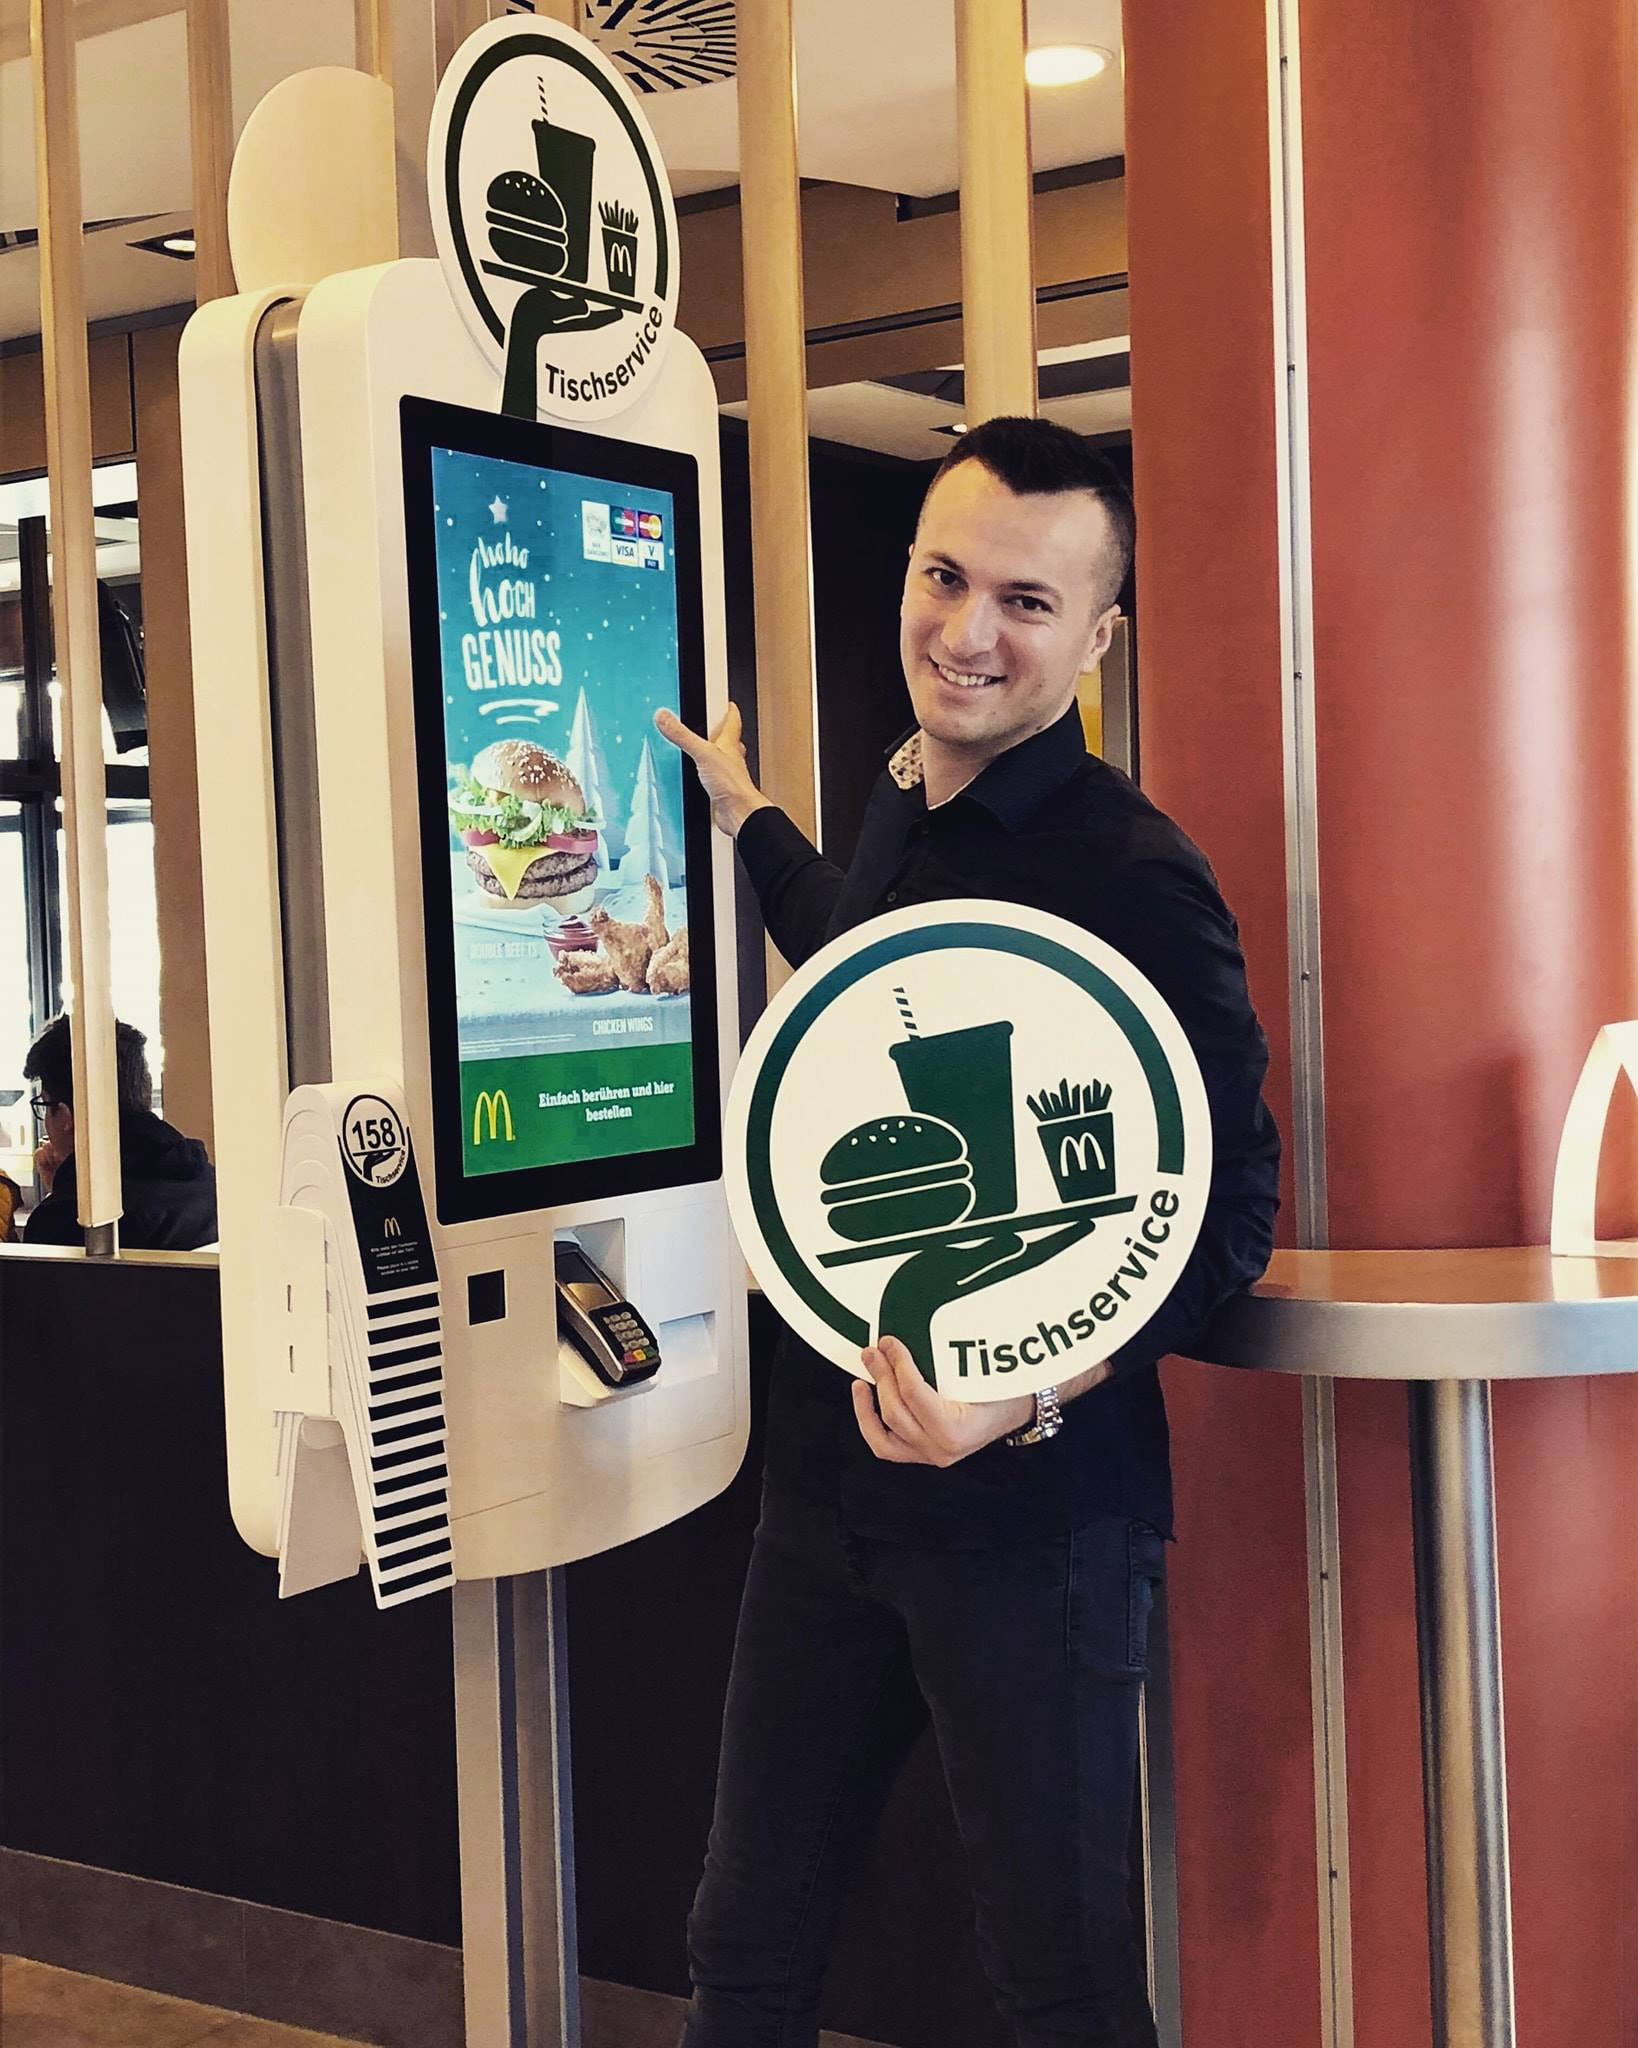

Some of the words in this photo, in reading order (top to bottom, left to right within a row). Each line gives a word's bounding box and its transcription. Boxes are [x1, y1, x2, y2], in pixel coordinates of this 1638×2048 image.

[544, 305, 663, 402] Tischservice
[616, 545, 635, 557] VISA
[461, 628, 563, 691] GENUSS
[592, 1018, 627, 1036] CHICKEN
[627, 1016, 654, 1033] WINGS
[538, 1090, 581, 1108] Einfach
[582, 1086, 631, 1103] berühren
[632, 1082, 652, 1098] und
[653, 1081, 675, 1095] hier
[585, 1105, 633, 1122] bestellen
[352, 1117, 396, 1151] 158
[375, 1149, 406, 1184] Tischservice
[948, 1188, 1180, 1378] Tischservice
